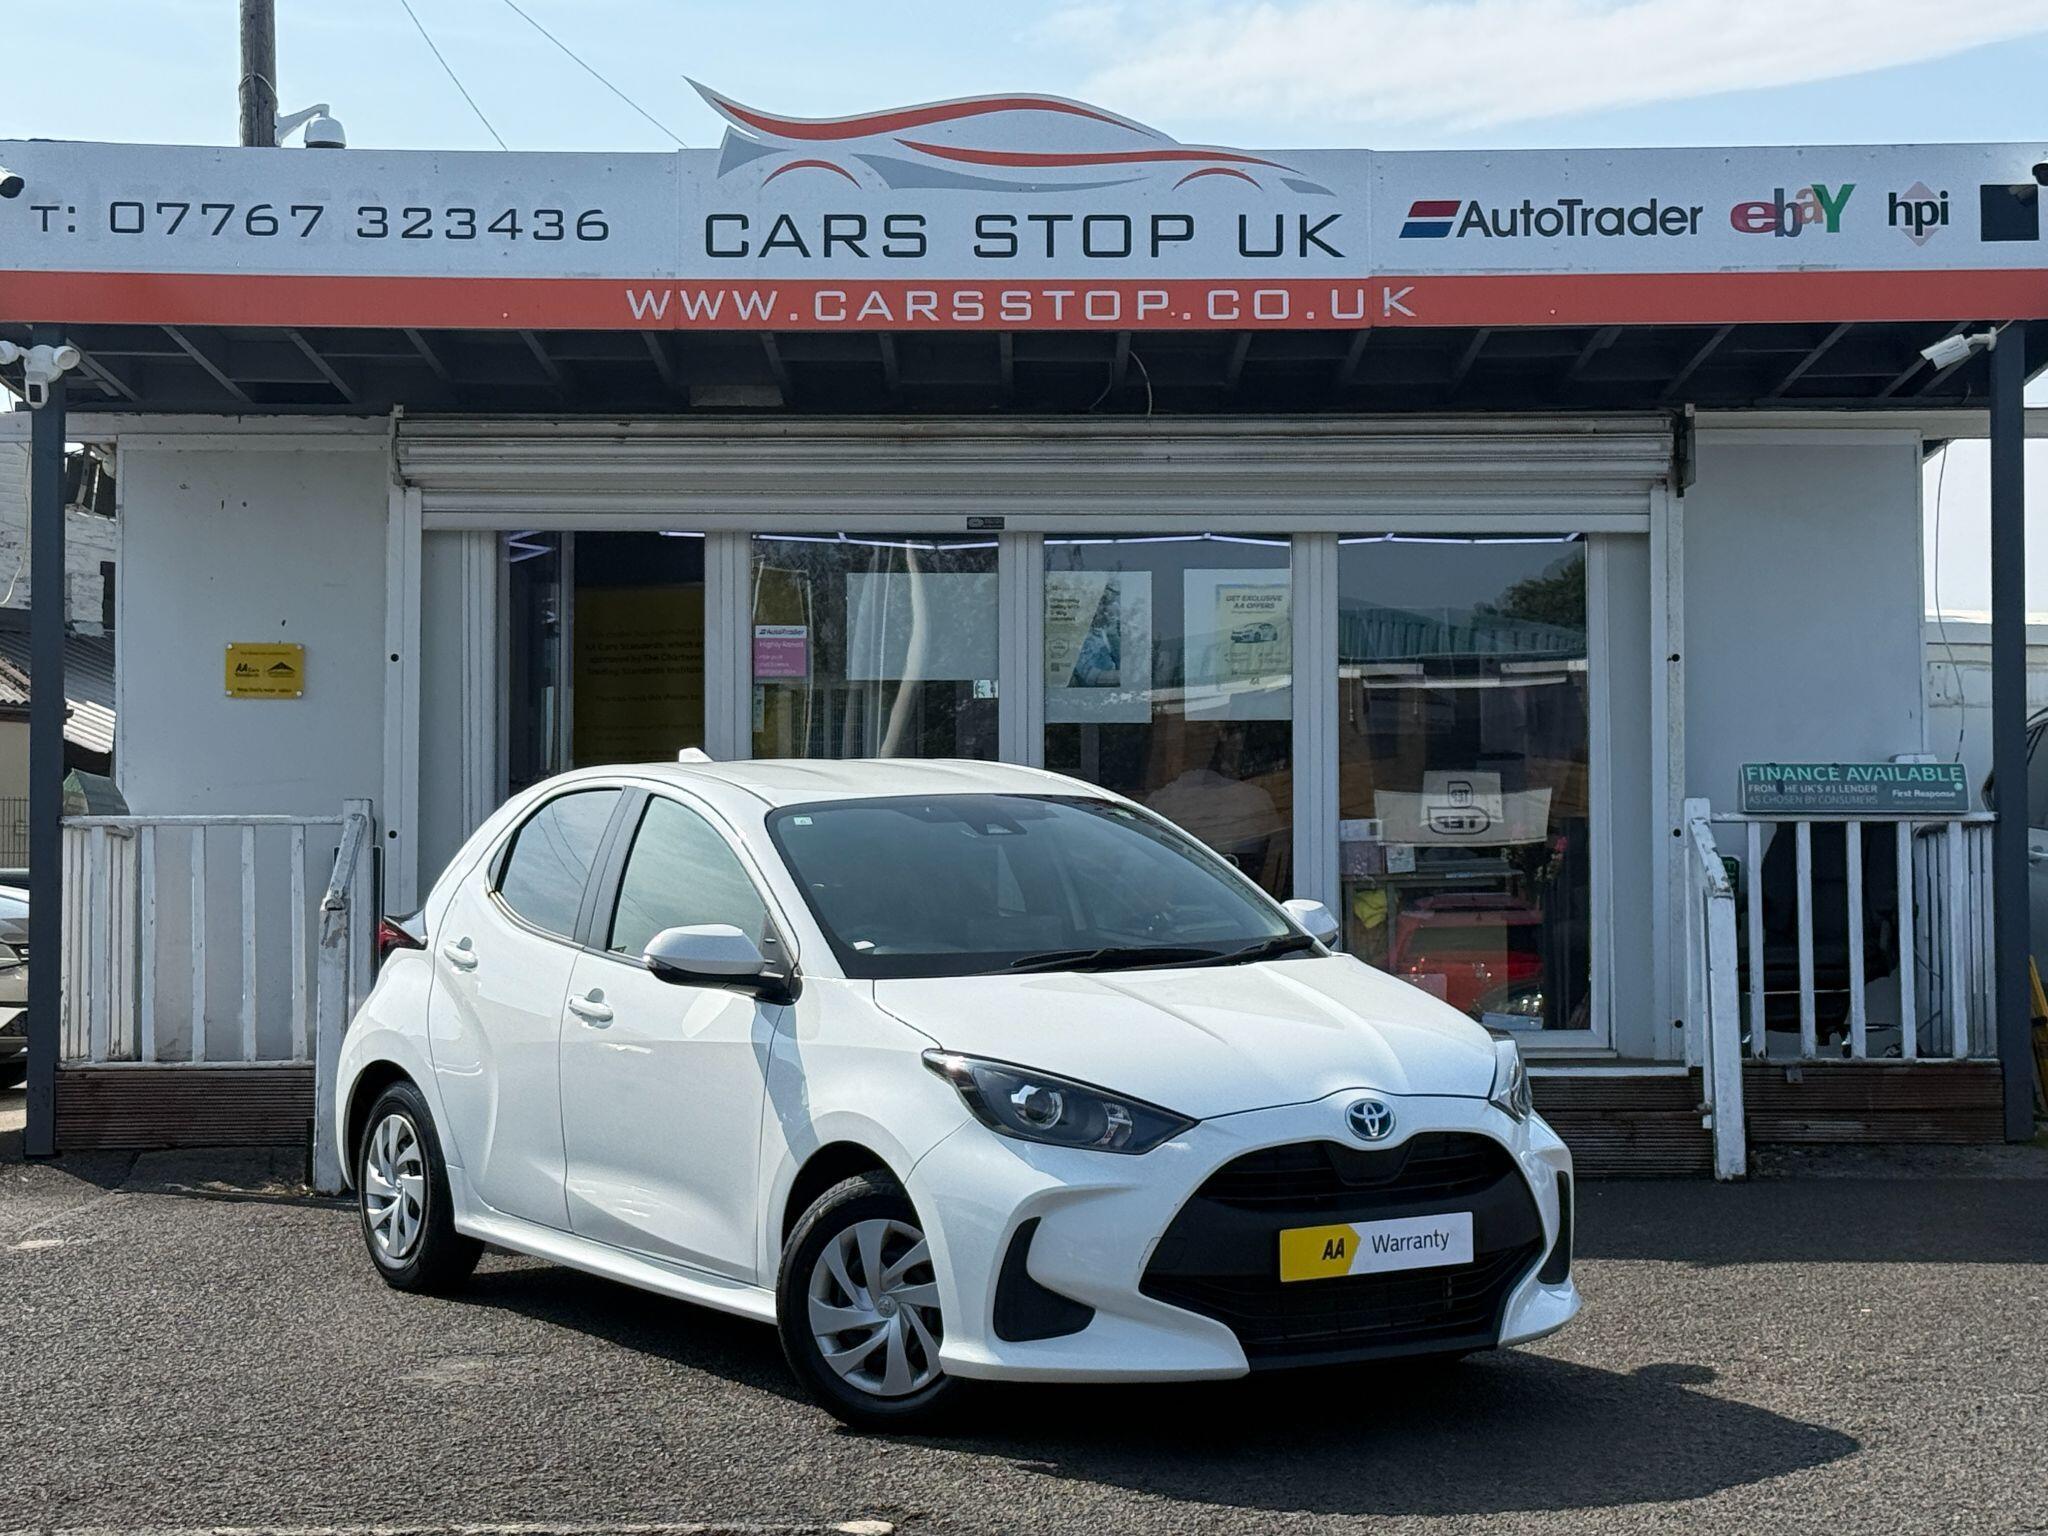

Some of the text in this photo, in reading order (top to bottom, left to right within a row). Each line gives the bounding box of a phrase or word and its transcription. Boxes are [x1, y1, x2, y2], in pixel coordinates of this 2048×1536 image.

[30, 201, 609, 241] T: 07767 323436
[1456, 198, 1704, 238] AutoTrader
[1888, 190, 1949, 236] hpi
[705, 213, 1346, 258] CARS STOP UK
[626, 286, 1417, 322] WWW.CARSSTOP.CO.UK
[1746, 765, 1963, 782] FINANCE AVAILABLE
[1748, 784, 1776, 793] FROM
[1800, 784, 1824, 793] UK'S
[1838, 784, 1878, 793] LENDER
[1748, 795, 1762, 804] AS
[1763, 795, 1802, 804] CHOSEN
[1817, 795, 1879, 804] CONSUMERS
[1892, 788, 1956, 799] First Response
[1322, 1229, 1450, 1260] AA Warranty
